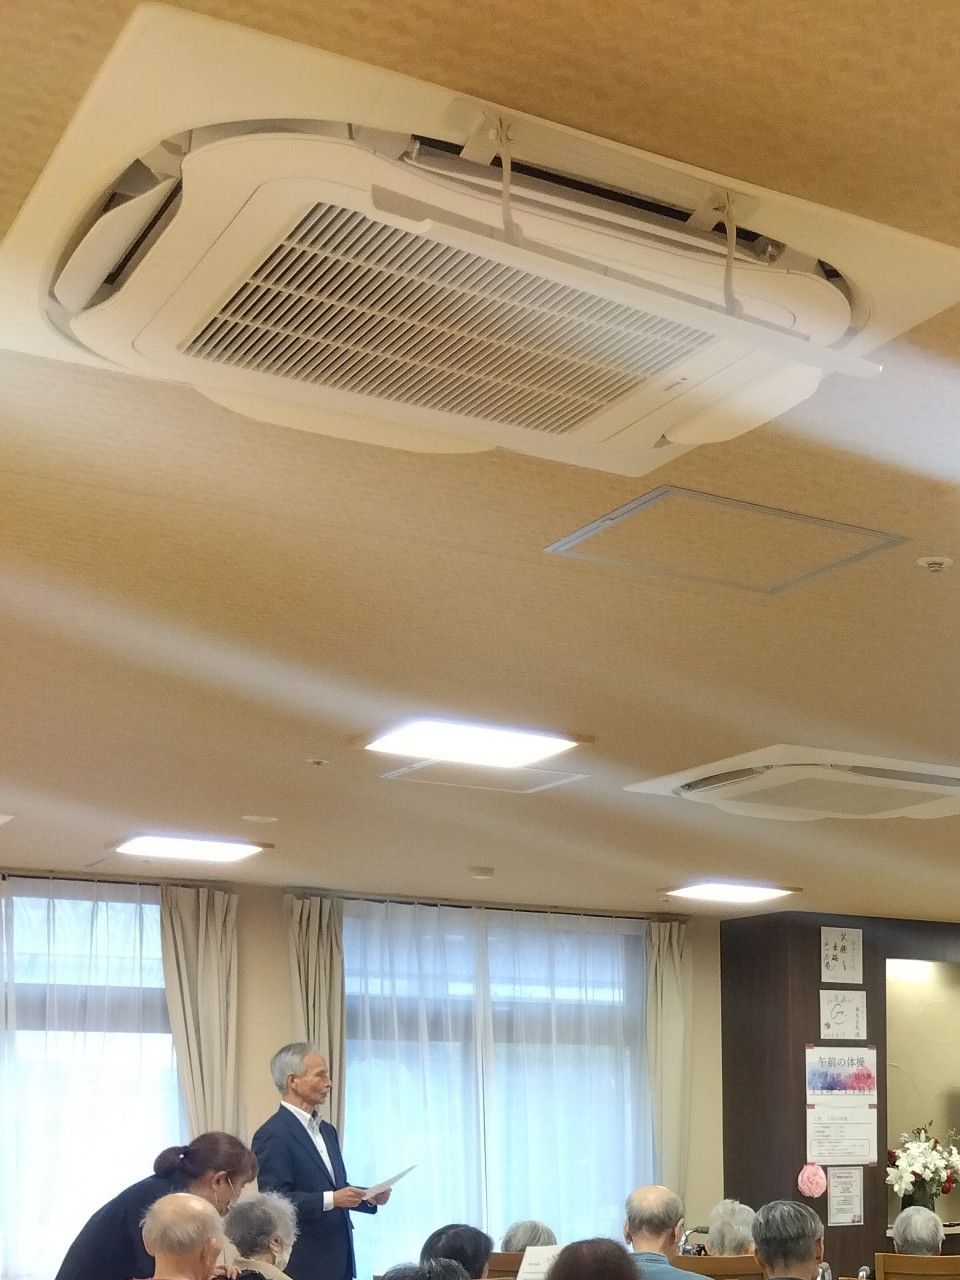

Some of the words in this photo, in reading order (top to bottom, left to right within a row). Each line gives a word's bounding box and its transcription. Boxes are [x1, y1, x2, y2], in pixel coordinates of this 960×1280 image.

[818, 1056, 866, 1068] 午前の体操
